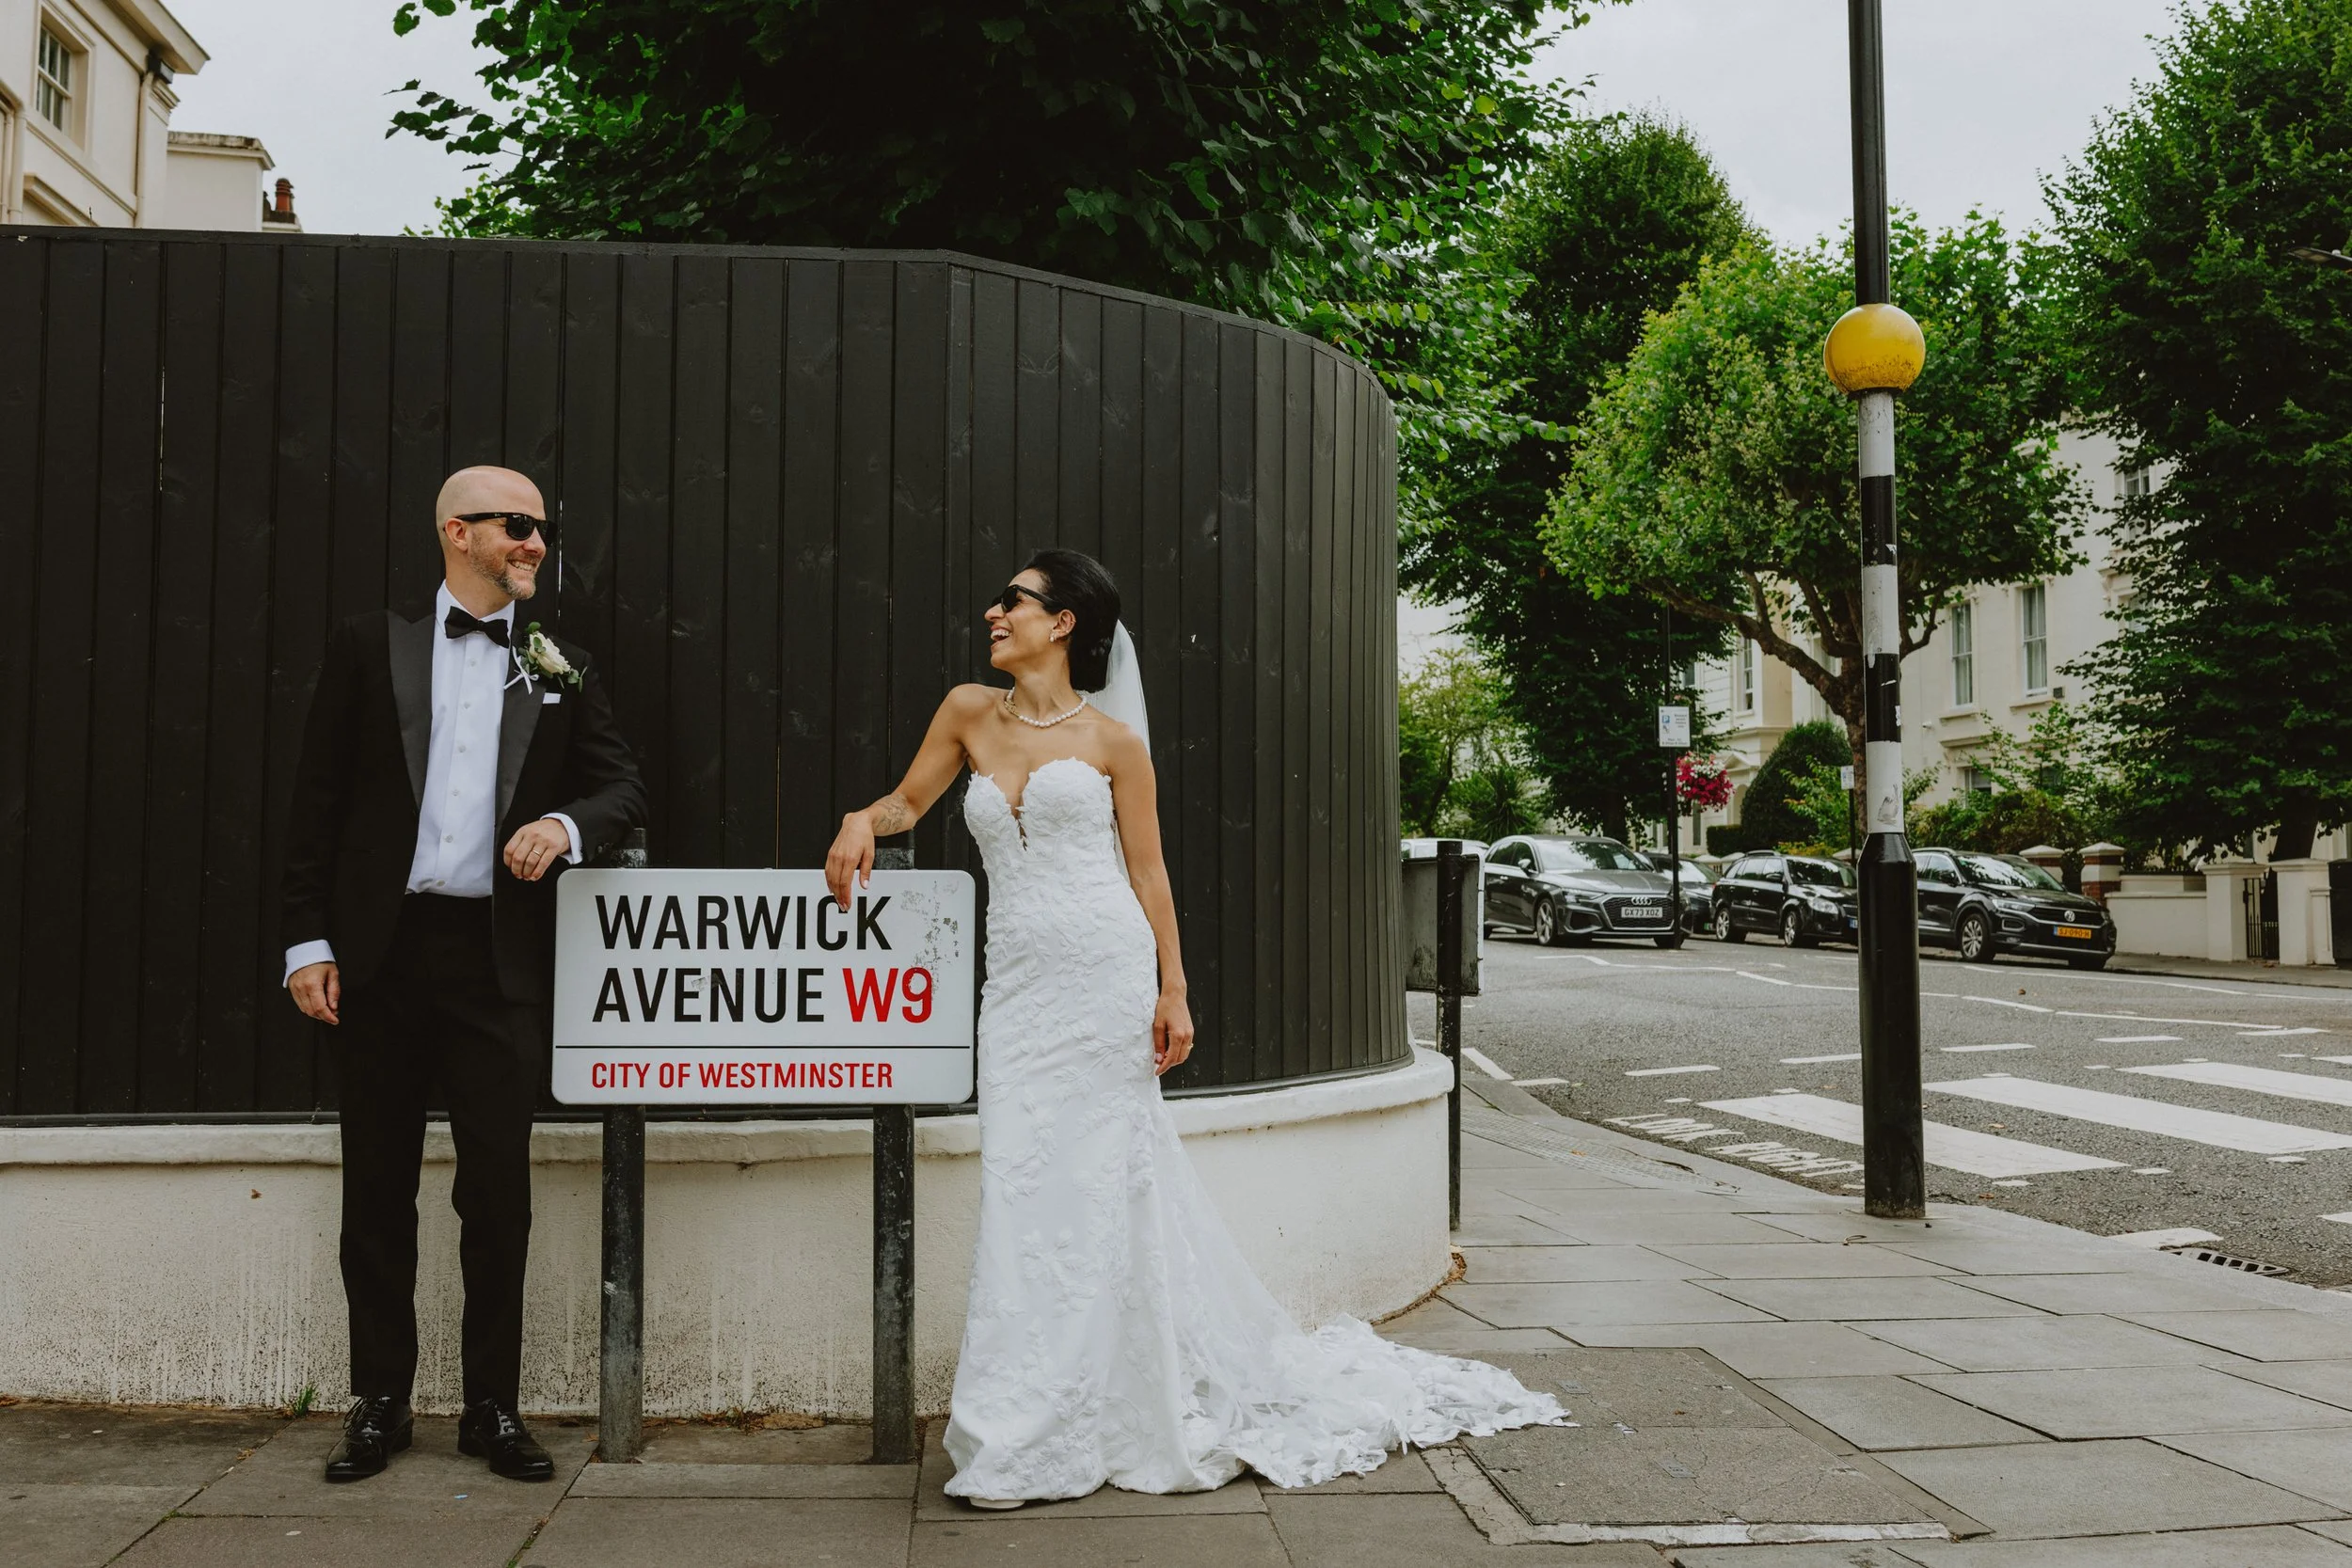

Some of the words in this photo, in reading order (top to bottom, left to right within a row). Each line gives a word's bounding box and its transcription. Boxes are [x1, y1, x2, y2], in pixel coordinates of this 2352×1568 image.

[595, 895, 893, 951] WARWICK
[592, 967, 824, 1023] AVENUE
[842, 967, 933, 1023] W9
[591, 1062, 650, 1089] CITY
[658, 1062, 691, 1089] OF
[698, 1062, 894, 1089] WESTMINSTER
[1601, 1114, 1745, 1143] LOOK
